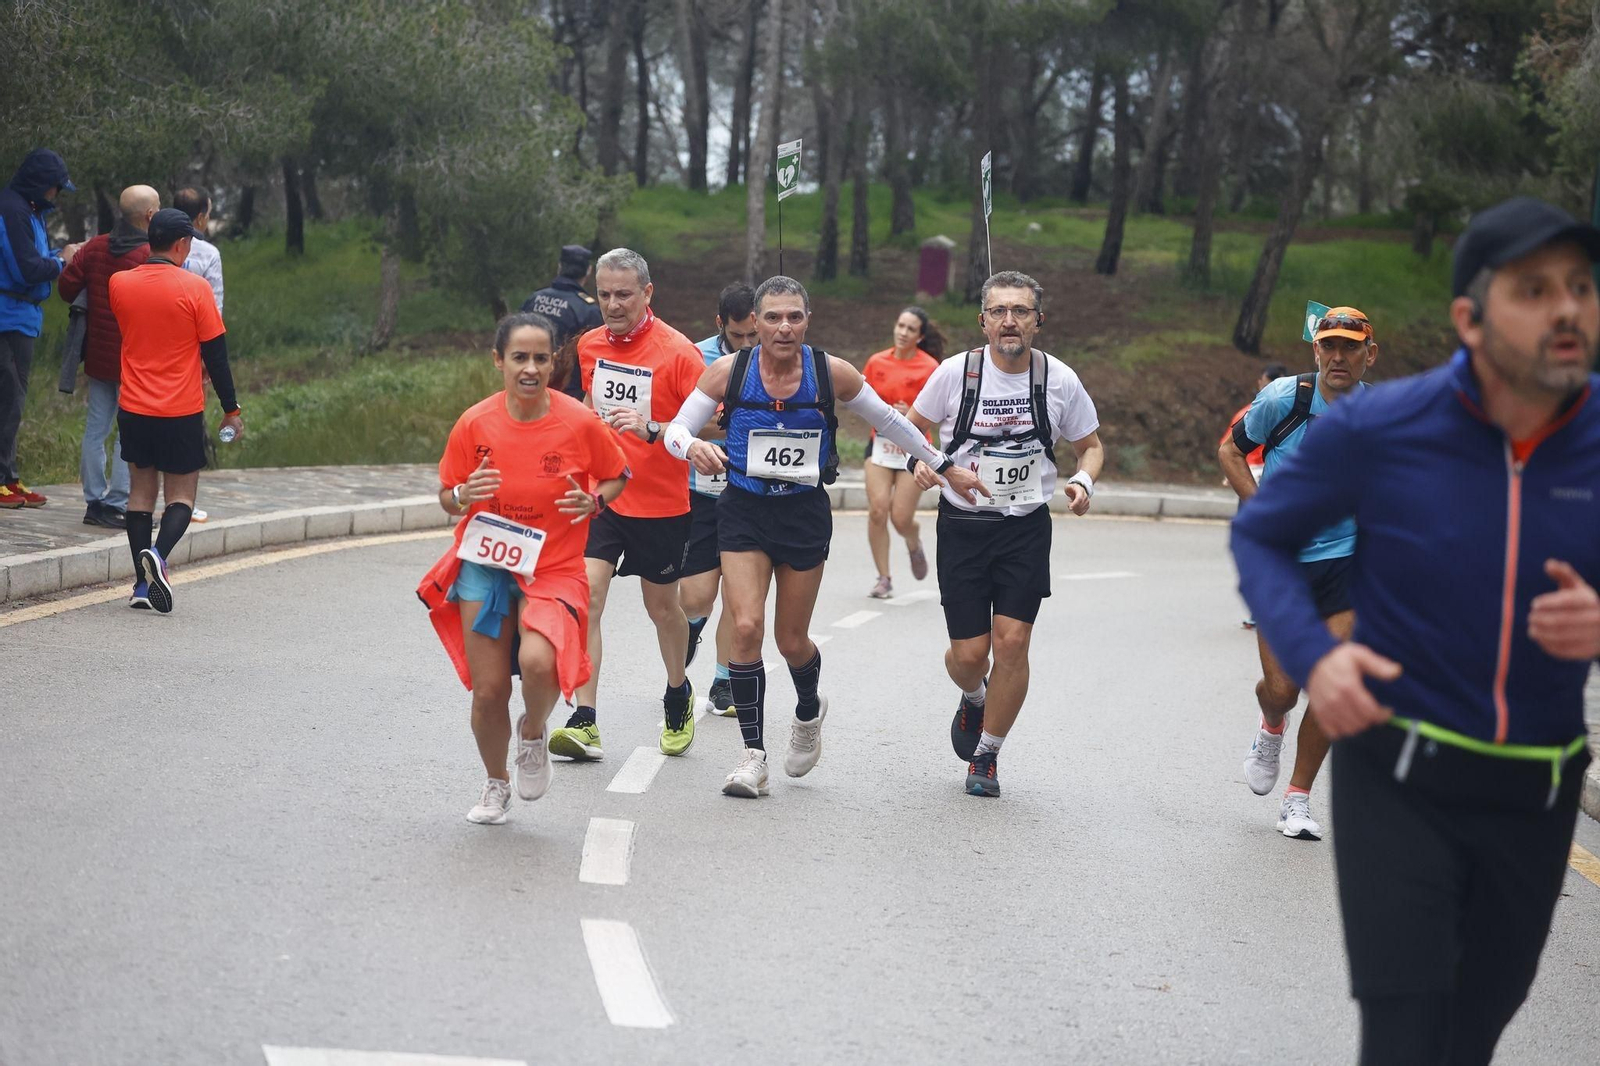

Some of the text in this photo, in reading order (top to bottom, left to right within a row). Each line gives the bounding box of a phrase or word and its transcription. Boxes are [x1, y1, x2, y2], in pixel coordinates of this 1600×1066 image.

[533, 303, 562, 317] LOCAL
[534, 295, 568, 309] POLICIA
[604, 380, 637, 403] 394
[764, 447, 805, 466] 462
[995, 464, 1030, 485] 190
[503, 503, 533, 512] Ciudad
[477, 535, 523, 567] 509
